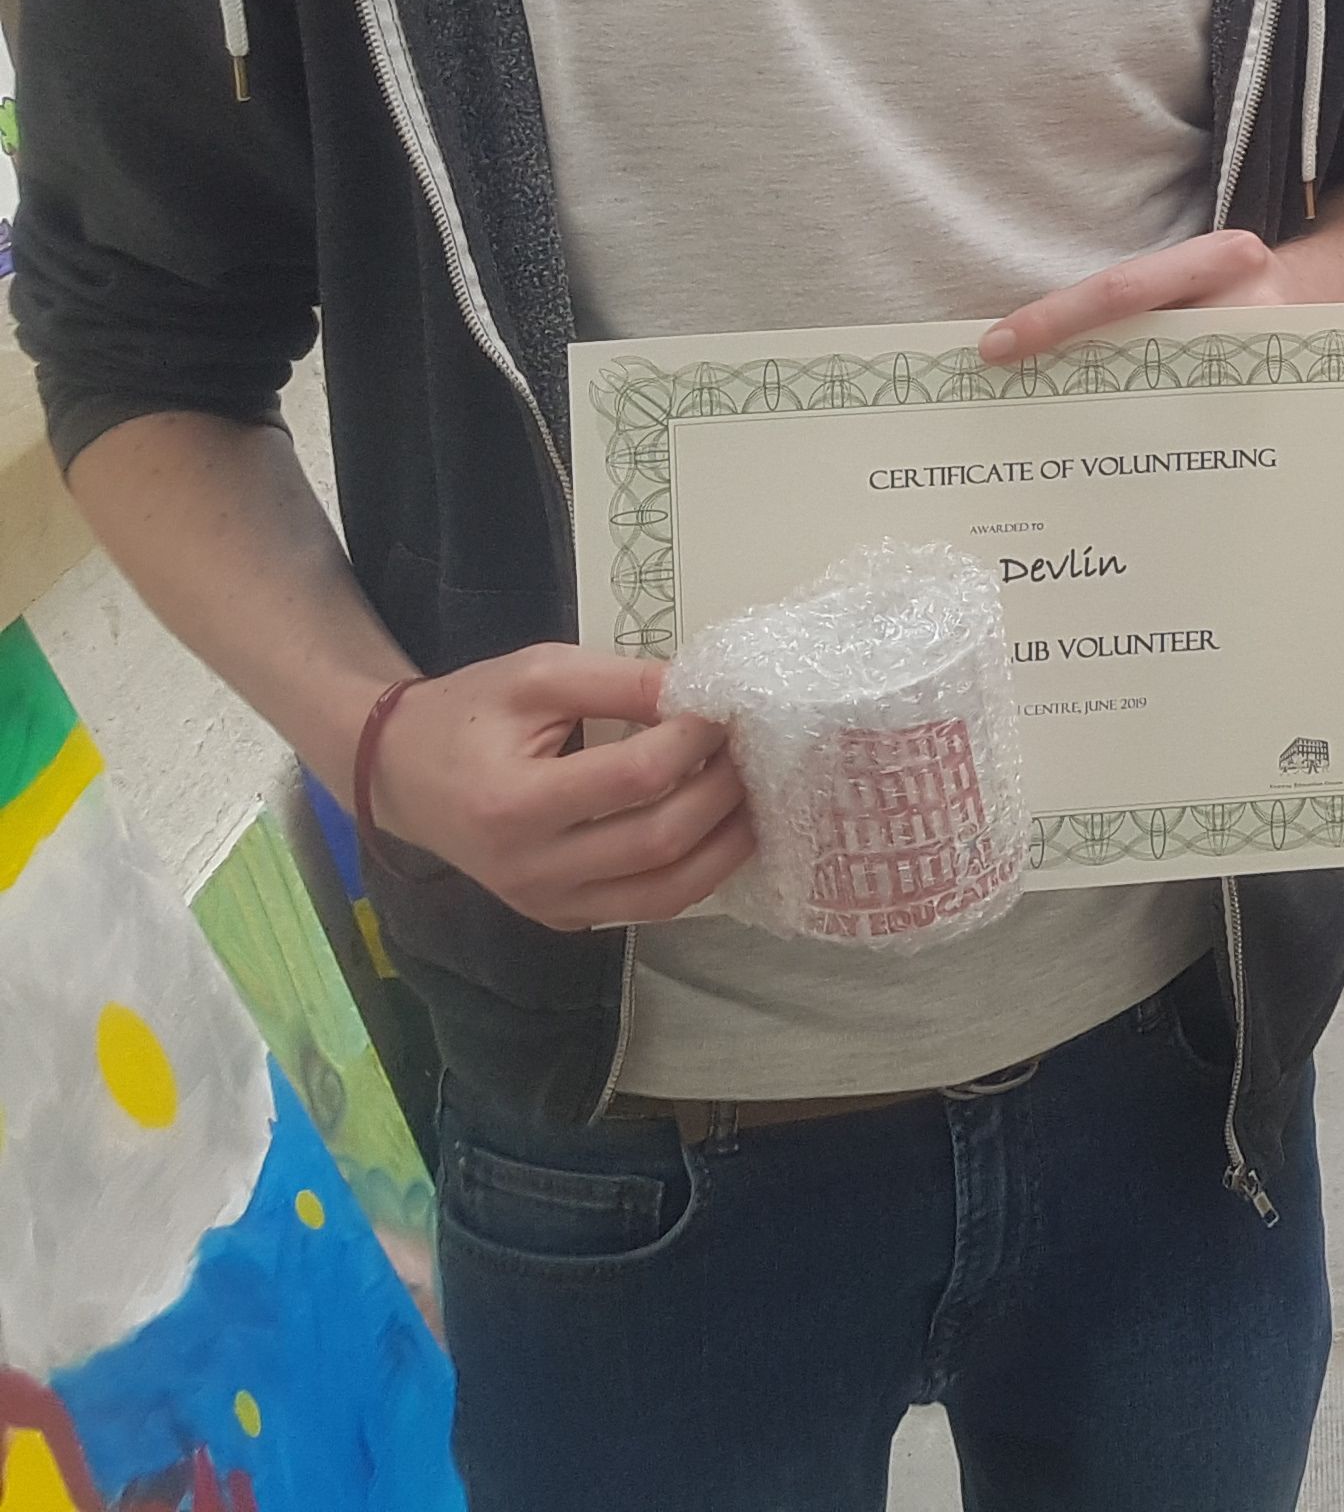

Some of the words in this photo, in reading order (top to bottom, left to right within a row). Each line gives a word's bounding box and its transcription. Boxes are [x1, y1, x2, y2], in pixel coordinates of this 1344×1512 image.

[869, 461, 1034, 490] CERTIFICATE
[1040, 459, 1074, 480] OF
[1081, 448, 1277, 477] VOLUNTEERING
[970, 522, 1029, 535] AWARDED
[1031, 522, 1044, 531] TO
[1000, 546, 1127, 584] Devlin
[1012, 641, 1050, 663] UB
[1058, 630, 1221, 659] VOLUNTEER
[1024, 700, 1082, 716] CENTRE,
[1084, 698, 1117, 714] JUNE
[1120, 697, 1147, 710] 2019
